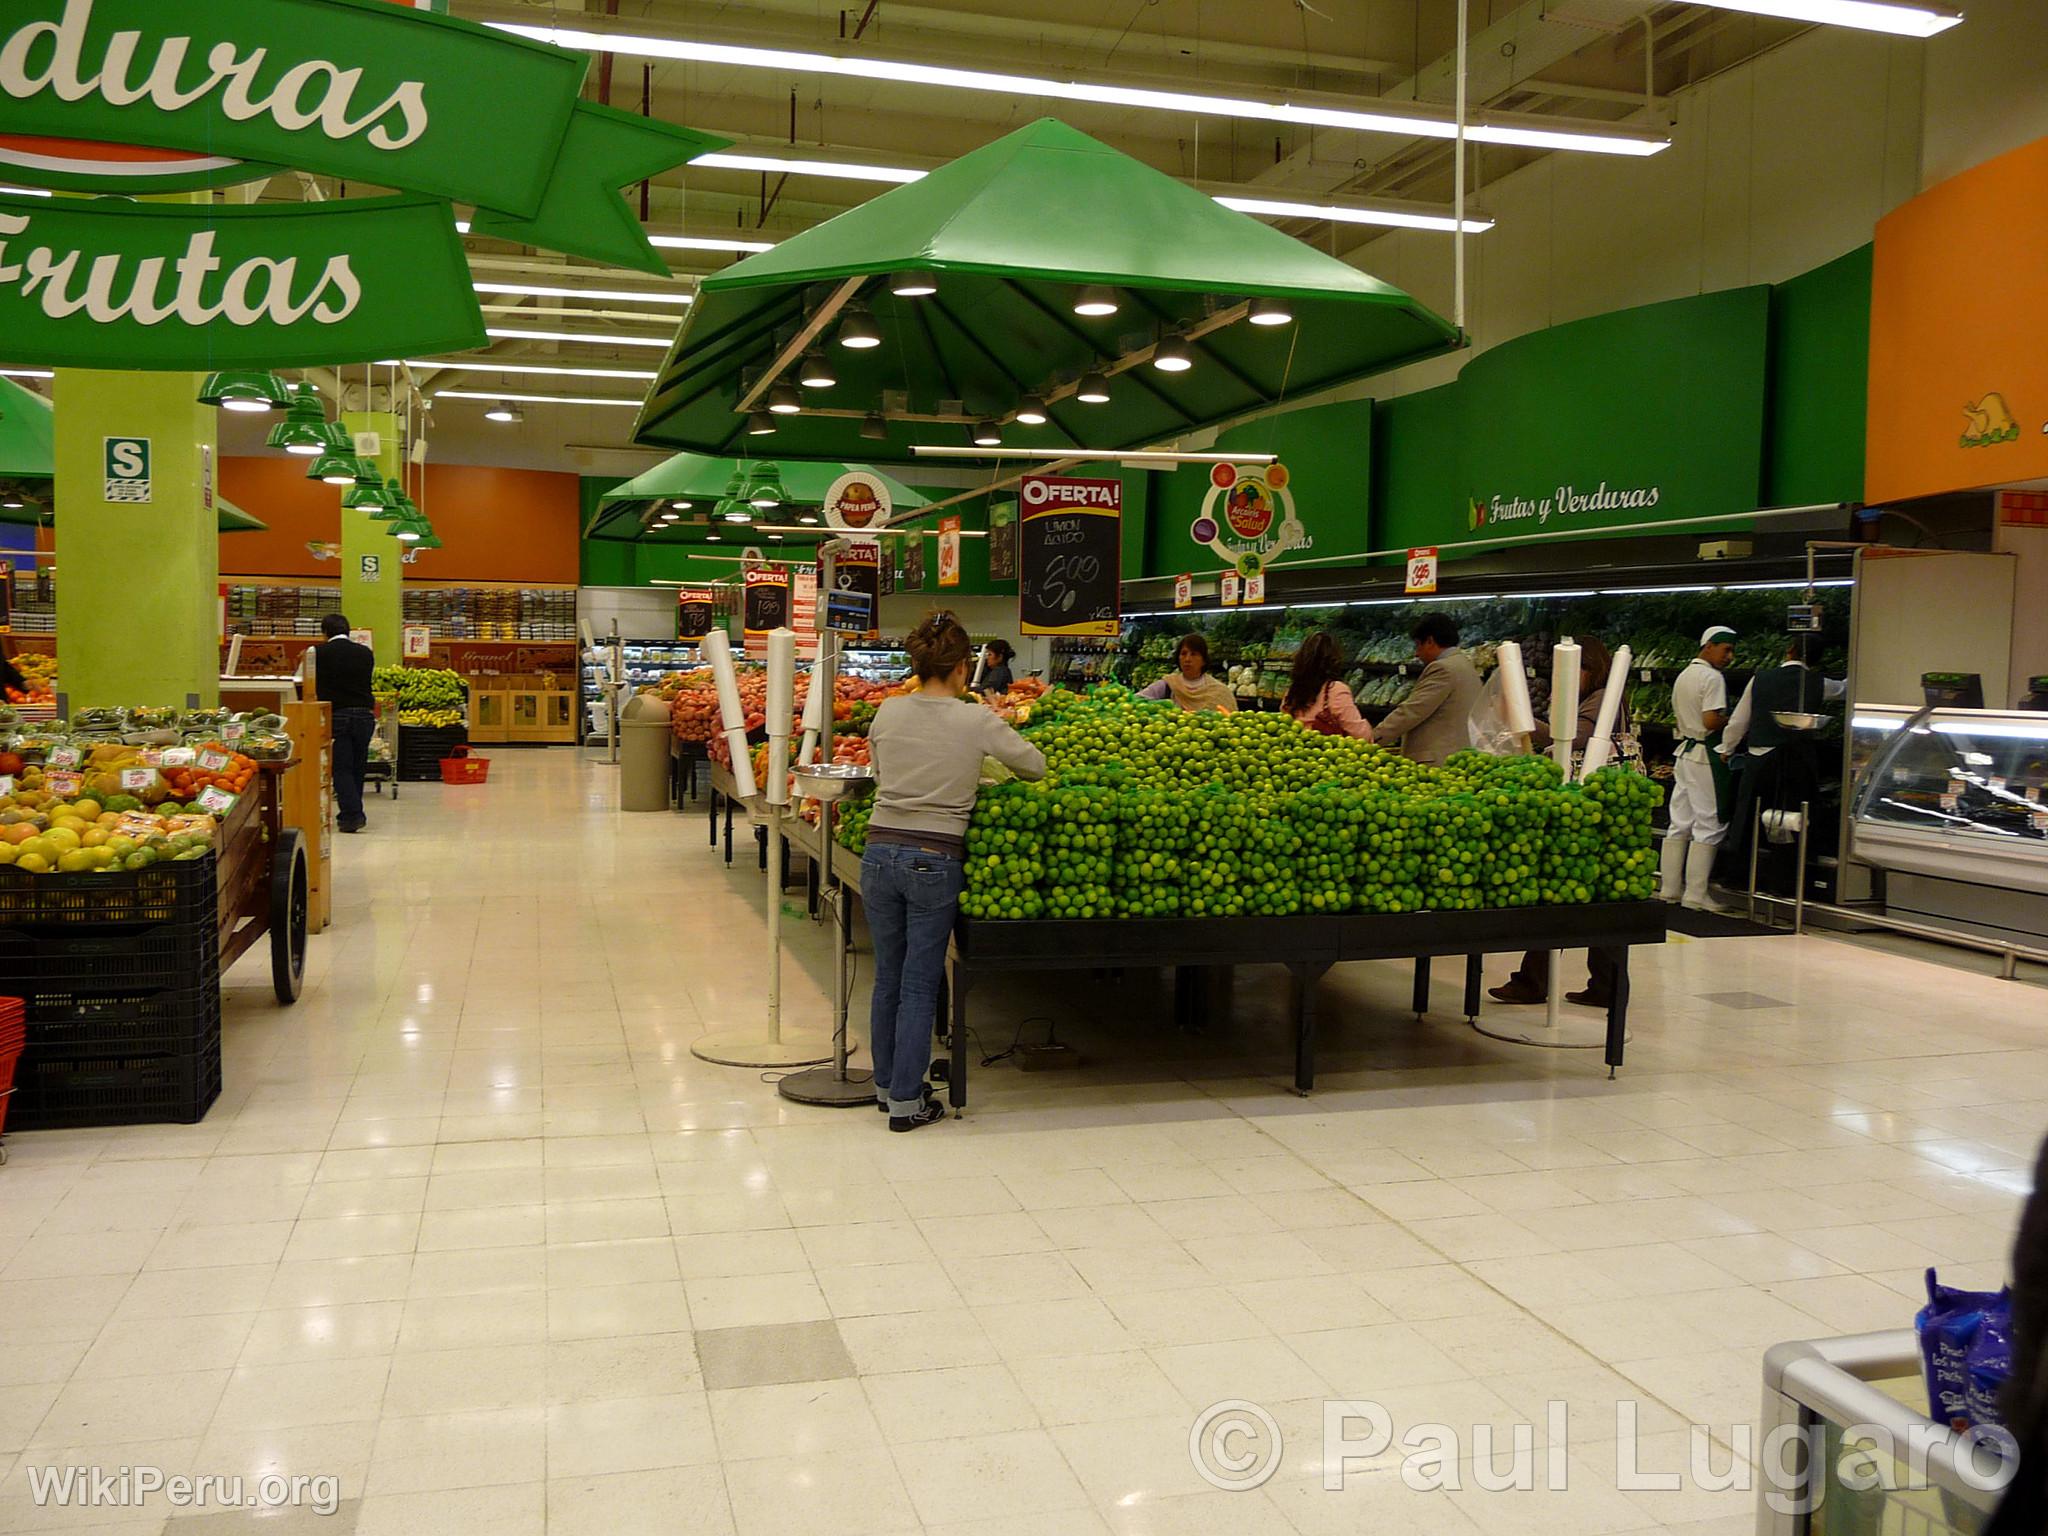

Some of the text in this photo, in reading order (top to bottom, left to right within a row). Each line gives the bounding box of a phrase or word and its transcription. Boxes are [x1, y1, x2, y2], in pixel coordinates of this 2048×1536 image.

[111, 441, 144, 478] S
[1022, 480, 1120, 507] OFERTA!
[1489, 481, 1660, 524] Frutas y Verduras
[1234, 515, 1265, 531] Salud
[363, 557, 377, 572] S
[746, 571, 788, 583] OFERTA!
[461, 650, 514, 661] Granel
